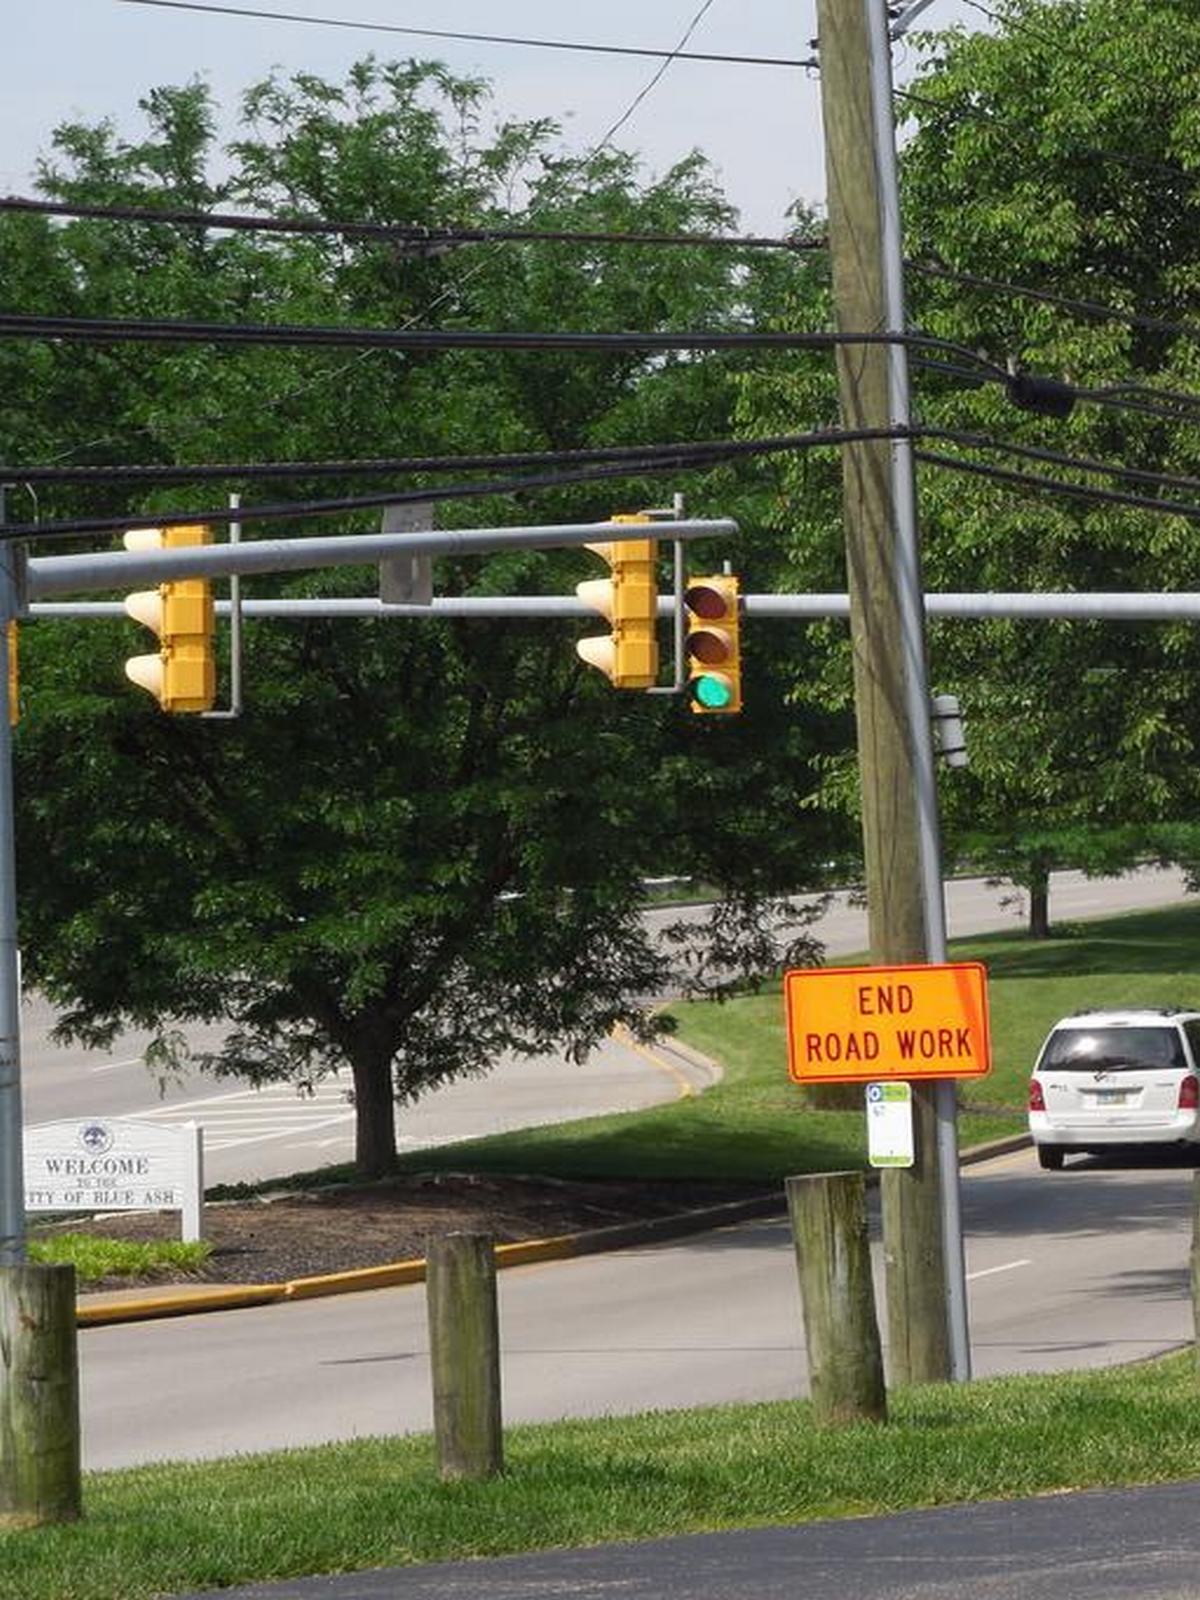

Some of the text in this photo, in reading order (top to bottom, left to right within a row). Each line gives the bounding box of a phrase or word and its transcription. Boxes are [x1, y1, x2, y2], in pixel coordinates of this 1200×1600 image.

[858, 985, 914, 1016] END
[806, 1027, 973, 1063] ROAD WORK
[46, 1158, 149, 1175] WELCOME
[28, 1190, 174, 1205] ITY OF BLUE ASH
